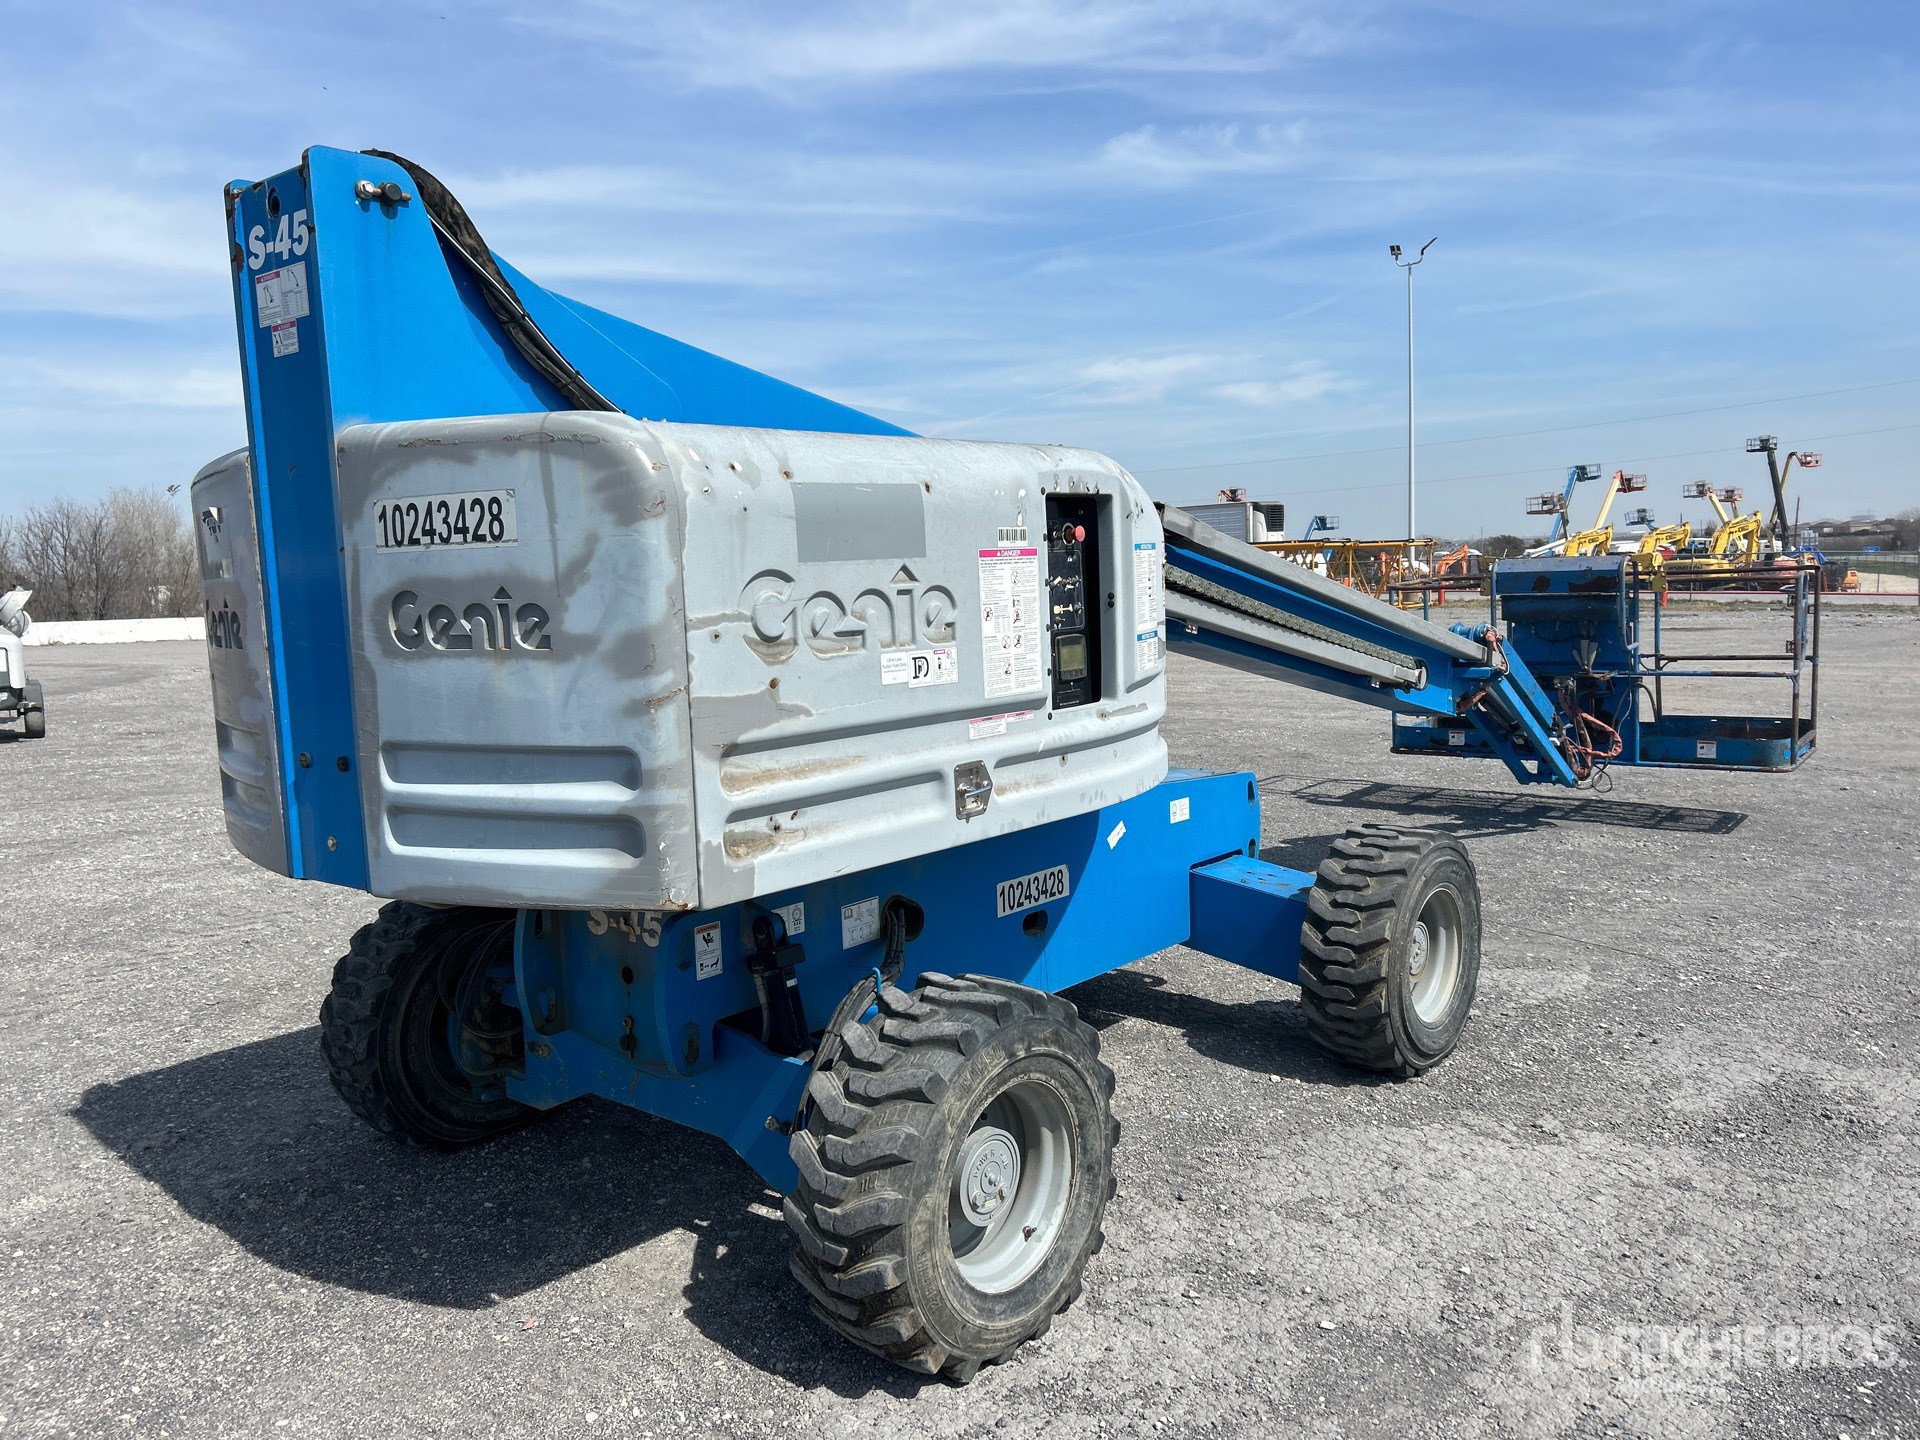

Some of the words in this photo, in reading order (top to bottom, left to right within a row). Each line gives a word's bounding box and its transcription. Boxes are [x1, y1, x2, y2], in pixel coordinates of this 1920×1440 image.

[248, 209, 309, 270] S-45
[378, 496, 505, 547] 10243428
[1001, 549, 1021, 557] DANGER
[388, 585, 552, 651] Genie
[740, 563, 958, 662] Genie
[999, 868, 1066, 911] 10243428
